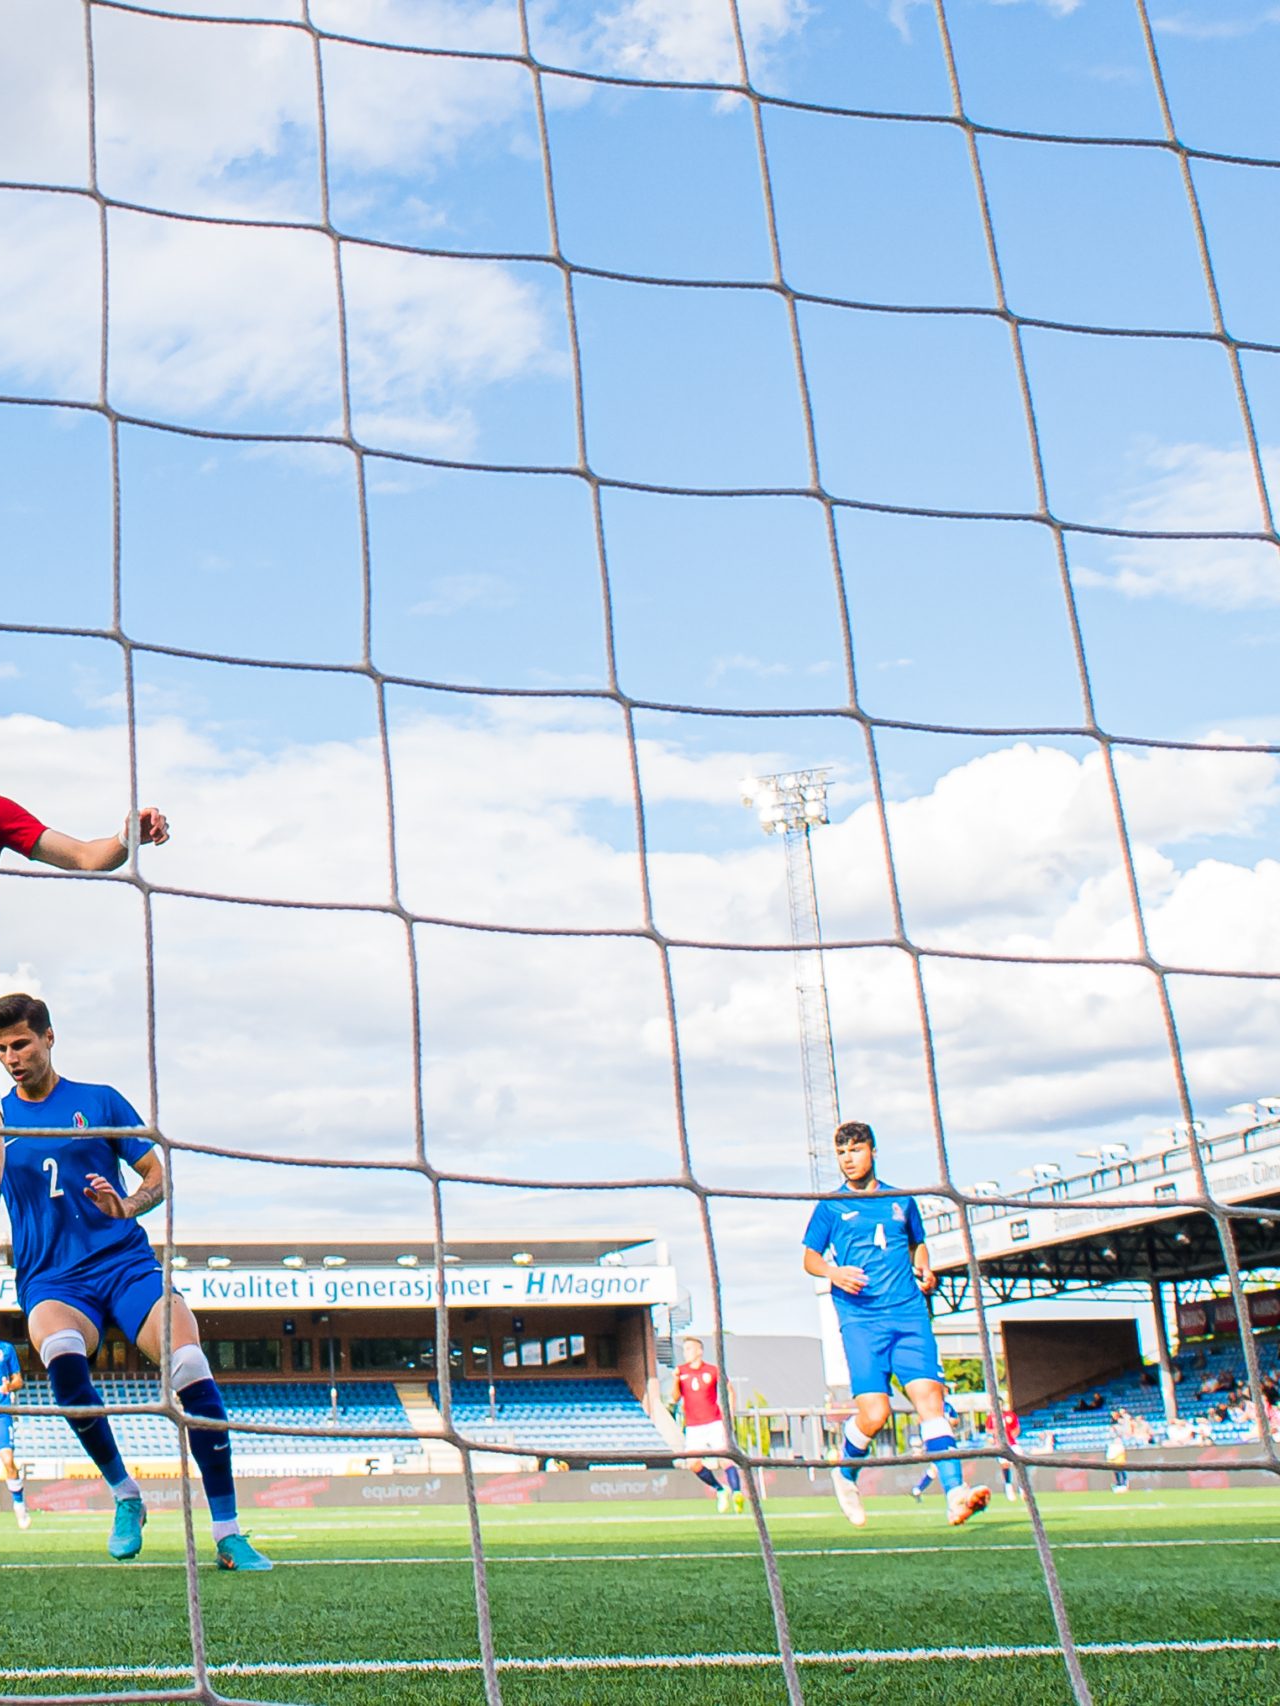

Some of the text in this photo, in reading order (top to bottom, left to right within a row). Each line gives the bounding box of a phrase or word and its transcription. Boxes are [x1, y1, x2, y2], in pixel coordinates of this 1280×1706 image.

[43, 1157, 65, 1198] 2
[873, 1223, 887, 1250] 4
[202, 1276, 300, 1298] Kvalitet
[308, 1276, 314, 1298] i
[324, 1274, 491, 1303] generasjoner
[551, 1273, 650, 1299] Magnor
[362, 1484, 420, 1502] equinor
[589, 1481, 648, 1497] equinor
